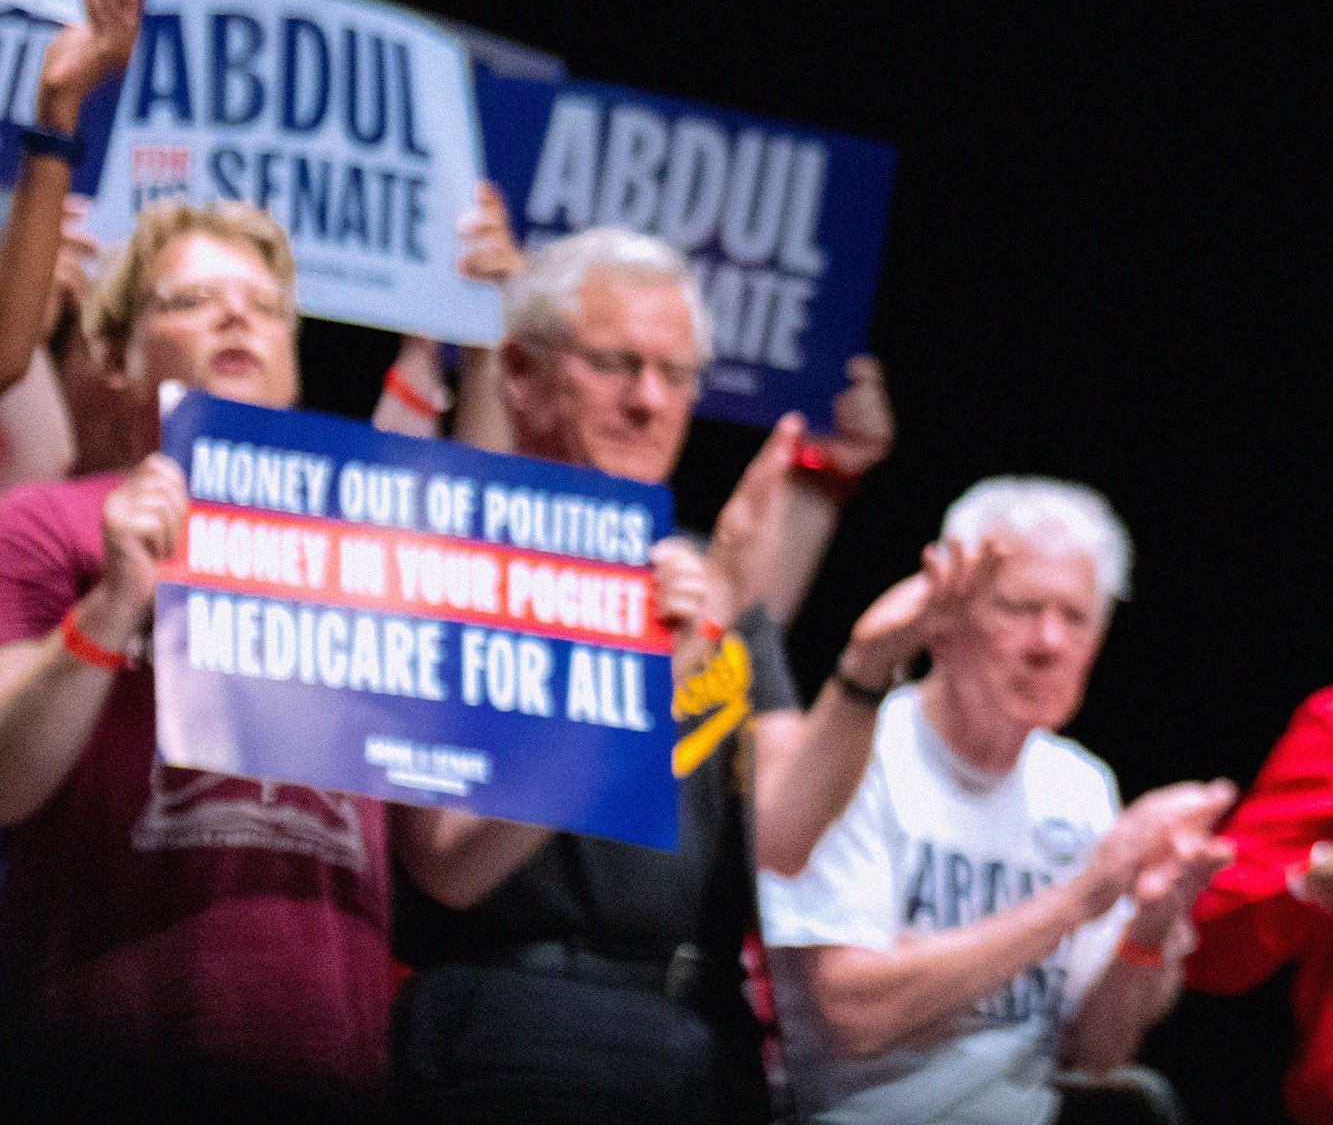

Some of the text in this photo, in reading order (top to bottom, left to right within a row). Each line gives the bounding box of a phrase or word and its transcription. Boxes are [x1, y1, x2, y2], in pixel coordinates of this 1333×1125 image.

[131, 11, 431, 159] ABDUL
[526, 94, 829, 272] ABDUL
[191, 438, 652, 566] MONEY OUT OF POLITICS
[186, 513, 646, 638] MONEY IN YOUR POCKET
[187, 589, 655, 733] MEDICARE FOR ALL
